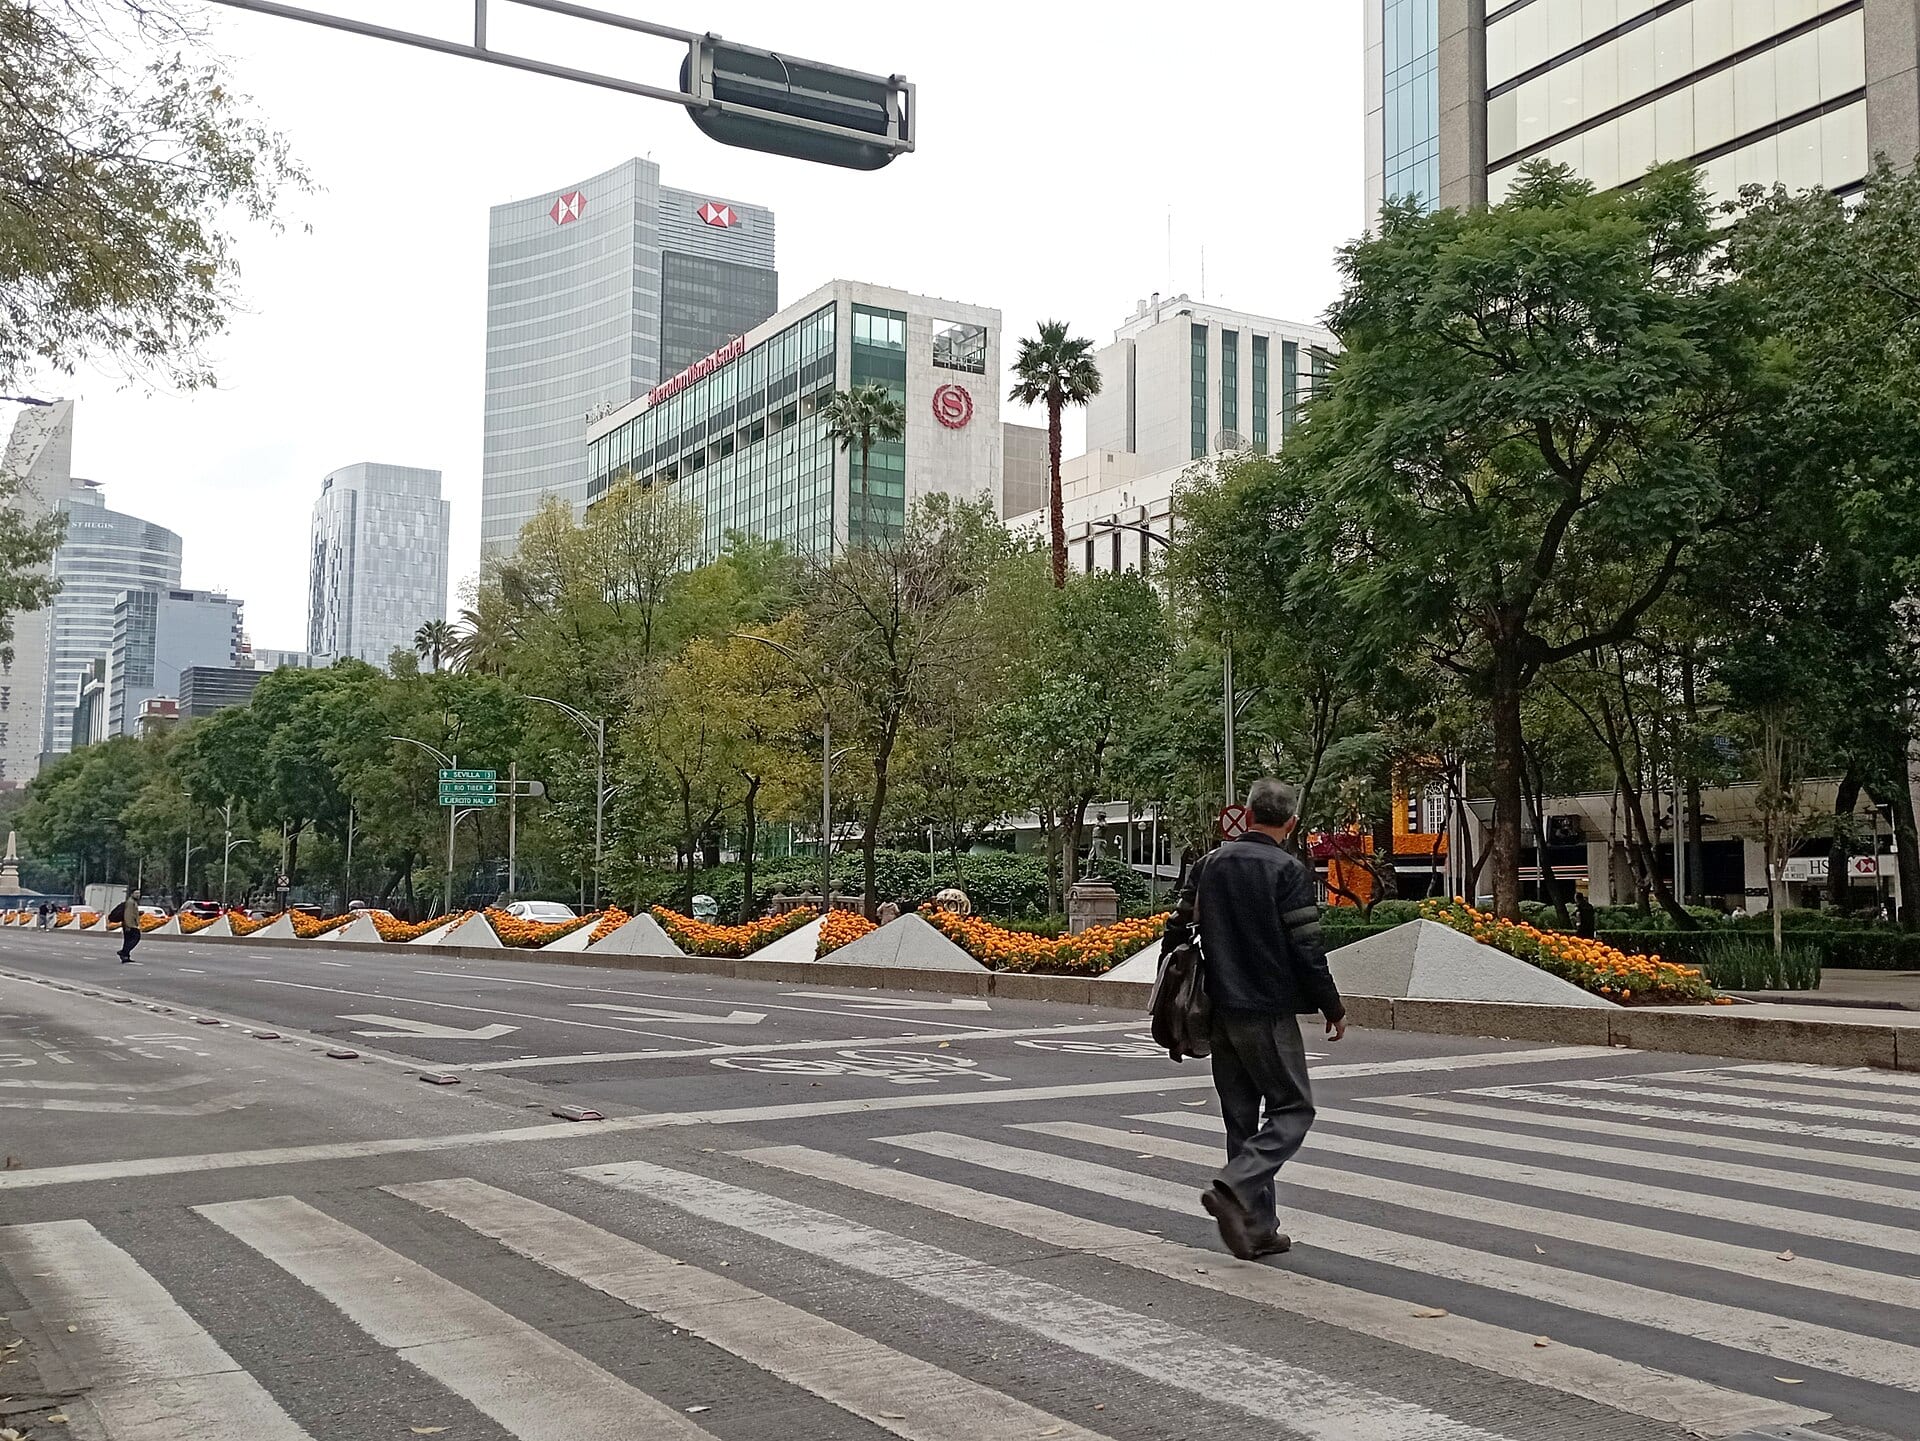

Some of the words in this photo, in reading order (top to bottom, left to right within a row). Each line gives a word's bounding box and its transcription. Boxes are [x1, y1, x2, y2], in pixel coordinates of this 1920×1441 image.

[647, 374, 687, 408] Sheraton
[715, 335, 745, 368] Isabel
[942, 391, 963, 417] S
